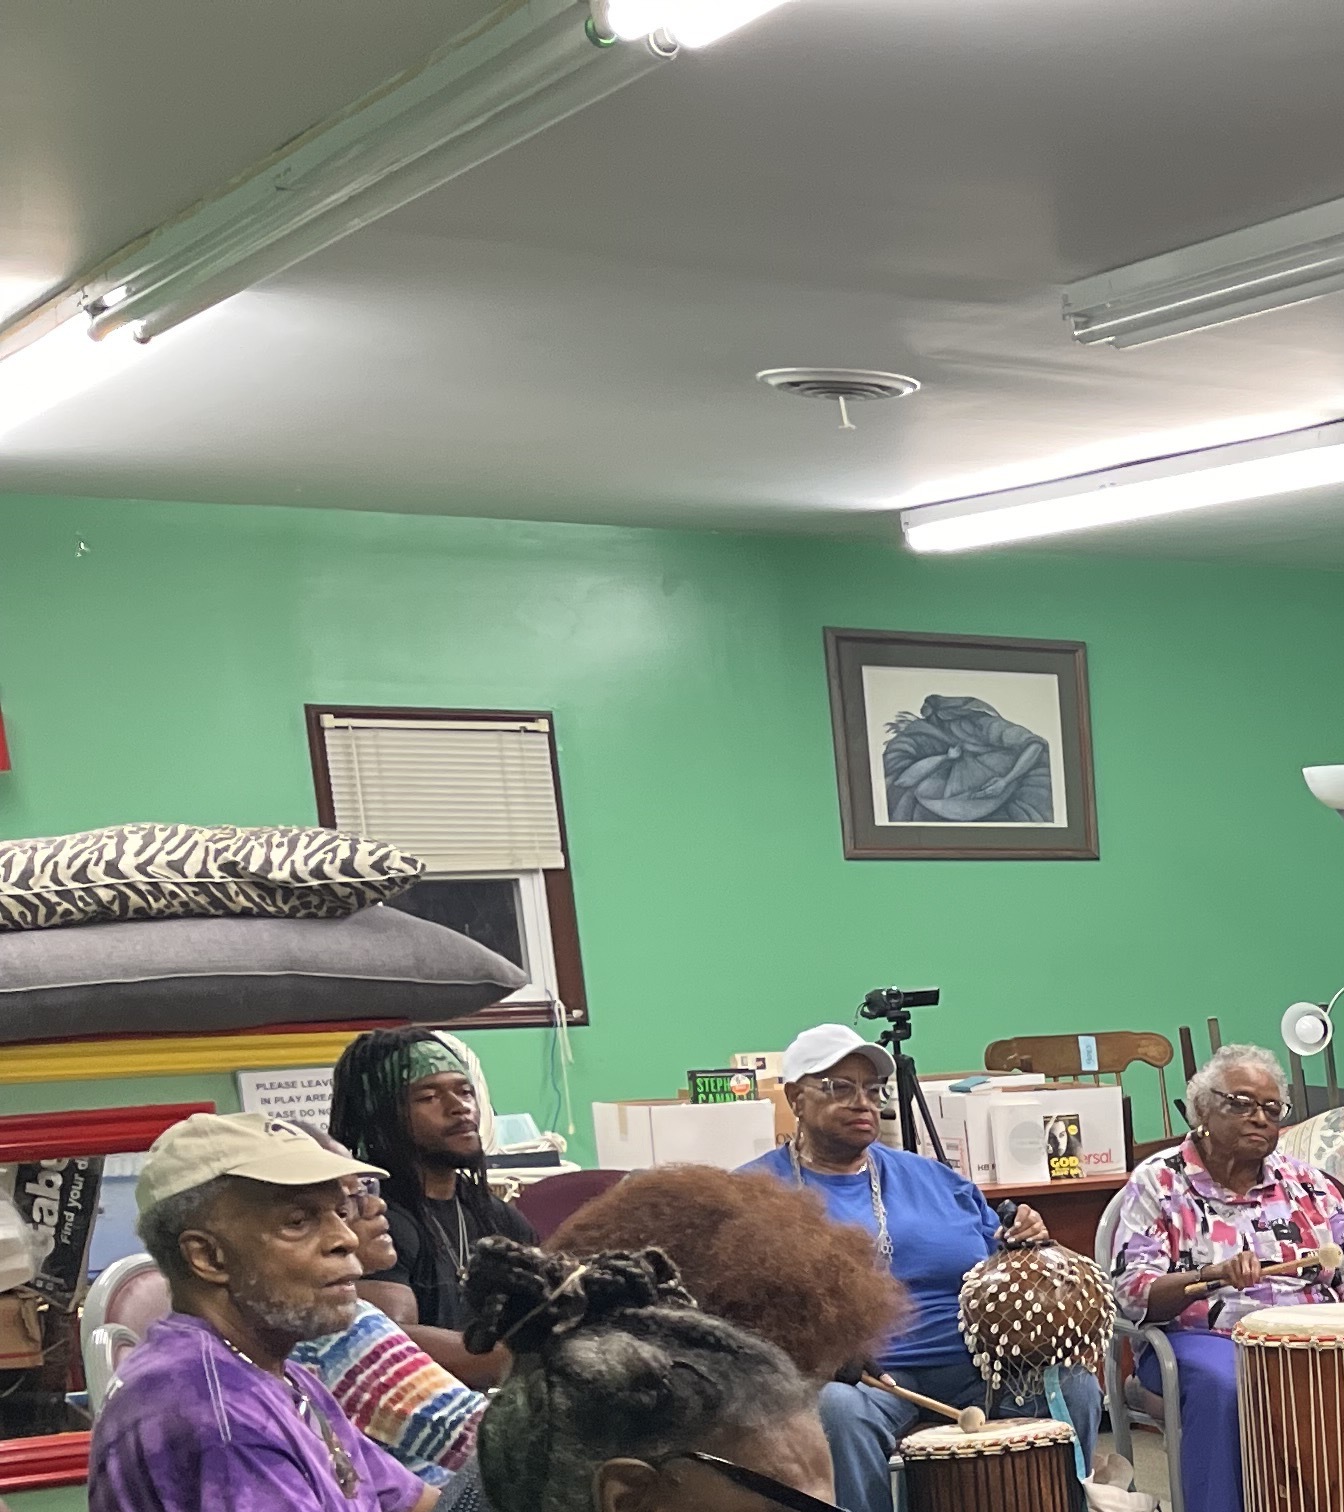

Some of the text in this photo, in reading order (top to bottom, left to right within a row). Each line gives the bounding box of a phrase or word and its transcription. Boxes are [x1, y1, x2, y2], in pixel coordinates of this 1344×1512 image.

[255, 1080, 298, 1091] PLEASE
[696, 1077, 731, 1092] STEPH
[260, 1096, 271, 1105] IN
[274, 1095, 302, 1104] PLAY
[267, 1107, 331, 1119] EASE DO NO
[1049, 1155, 1079, 1169] GOD
[1084, 1147, 1113, 1165] ersal
[67, 1173, 86, 1210] your
[60, 1210, 76, 1245] Find
